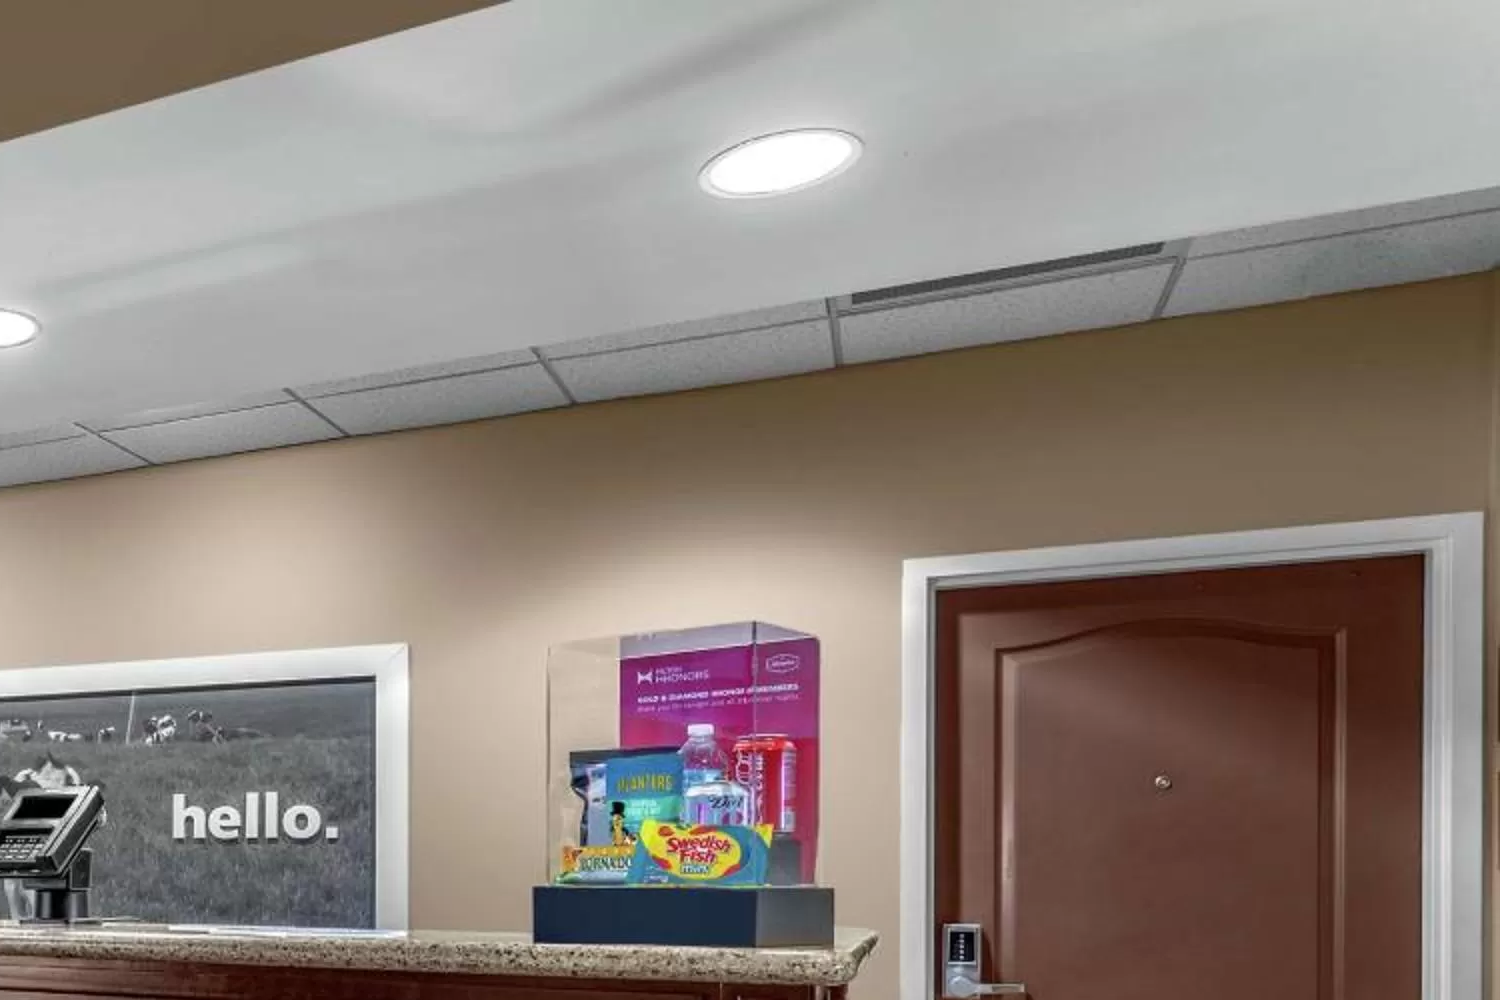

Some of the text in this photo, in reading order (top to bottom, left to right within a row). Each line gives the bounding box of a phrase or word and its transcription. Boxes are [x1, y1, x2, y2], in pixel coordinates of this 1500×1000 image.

[171, 791, 339, 840] hello.
[667, 835, 731, 853] Swedish
[680, 849, 717, 864] Fish
